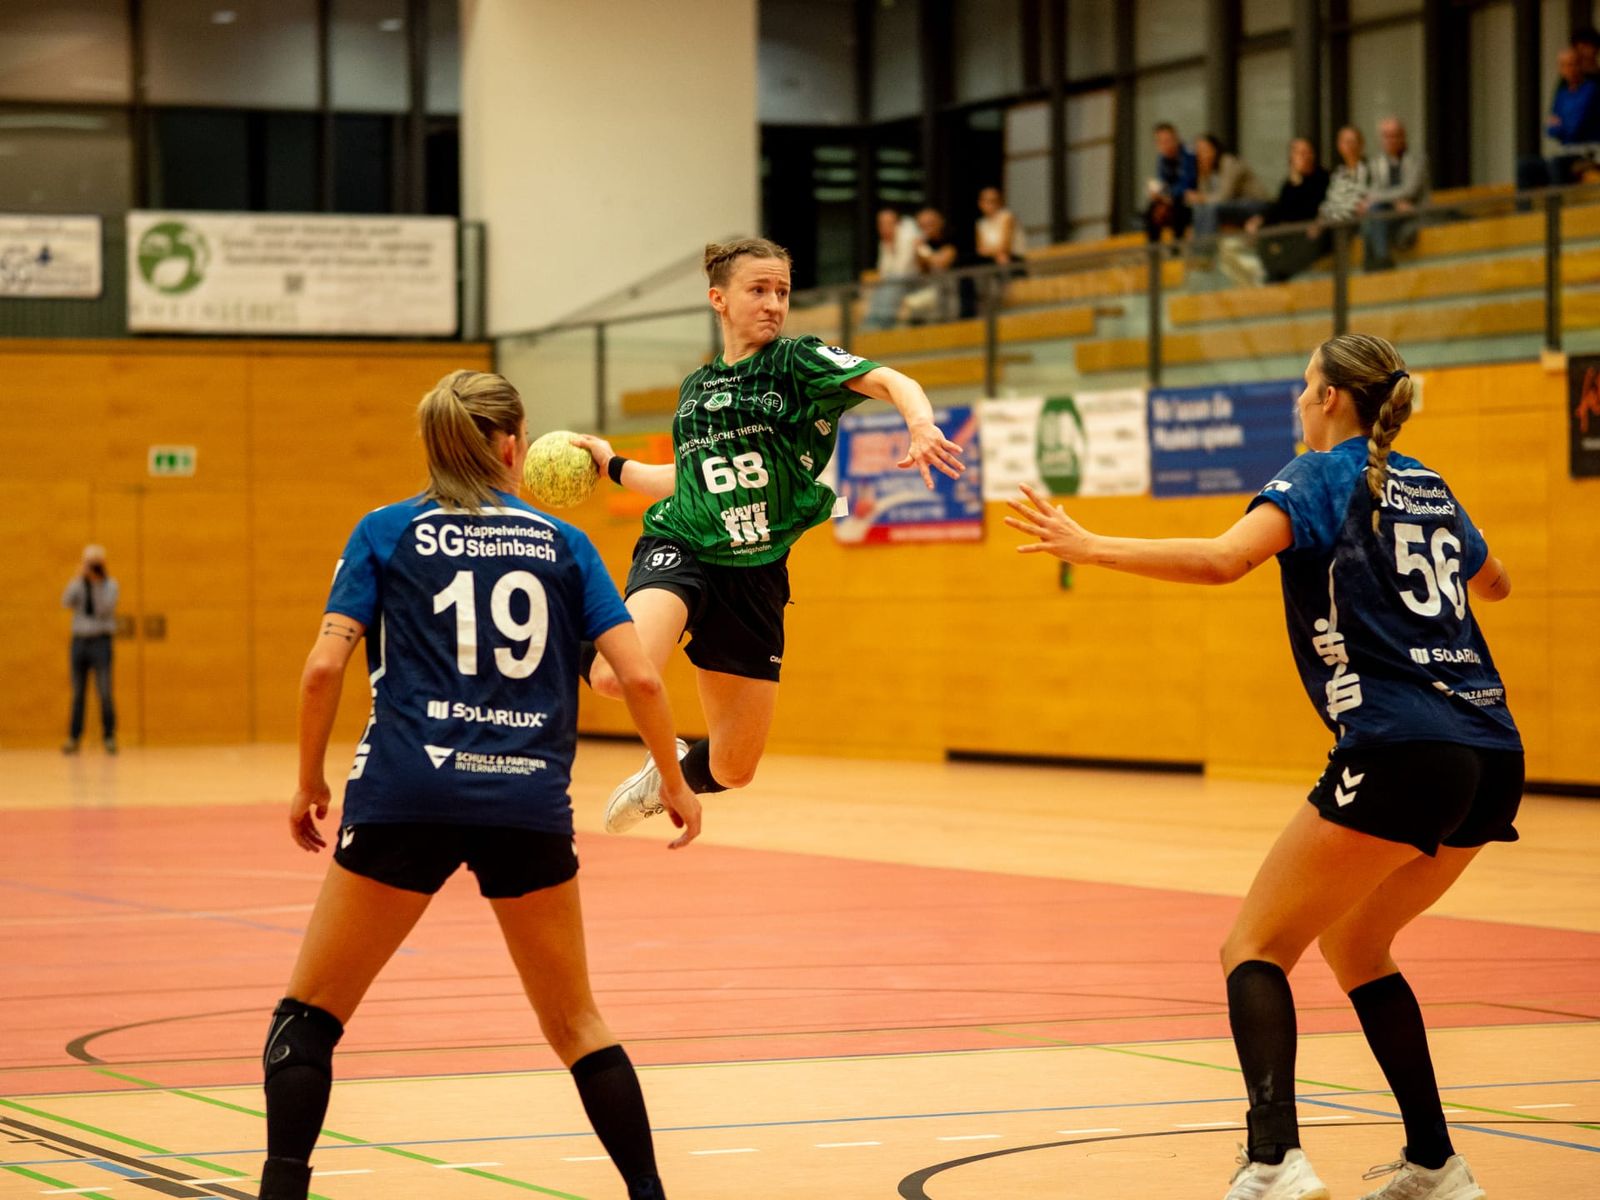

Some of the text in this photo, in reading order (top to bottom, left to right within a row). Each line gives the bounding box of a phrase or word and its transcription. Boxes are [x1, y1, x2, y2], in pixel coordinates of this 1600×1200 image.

[740, 395, 780, 409] LANGE
[701, 451, 769, 494] 68
[720, 501, 767, 521] clever
[414, 523, 465, 557] SG
[464, 525, 554, 542] Kappelwindeck
[724, 511, 771, 548] fit
[466, 539, 557, 562] Steinbach
[651, 552, 677, 567] 97
[1393, 522, 1466, 621] 56
[432, 570, 549, 680] 19
[452, 702, 544, 728] SOLARLUX
